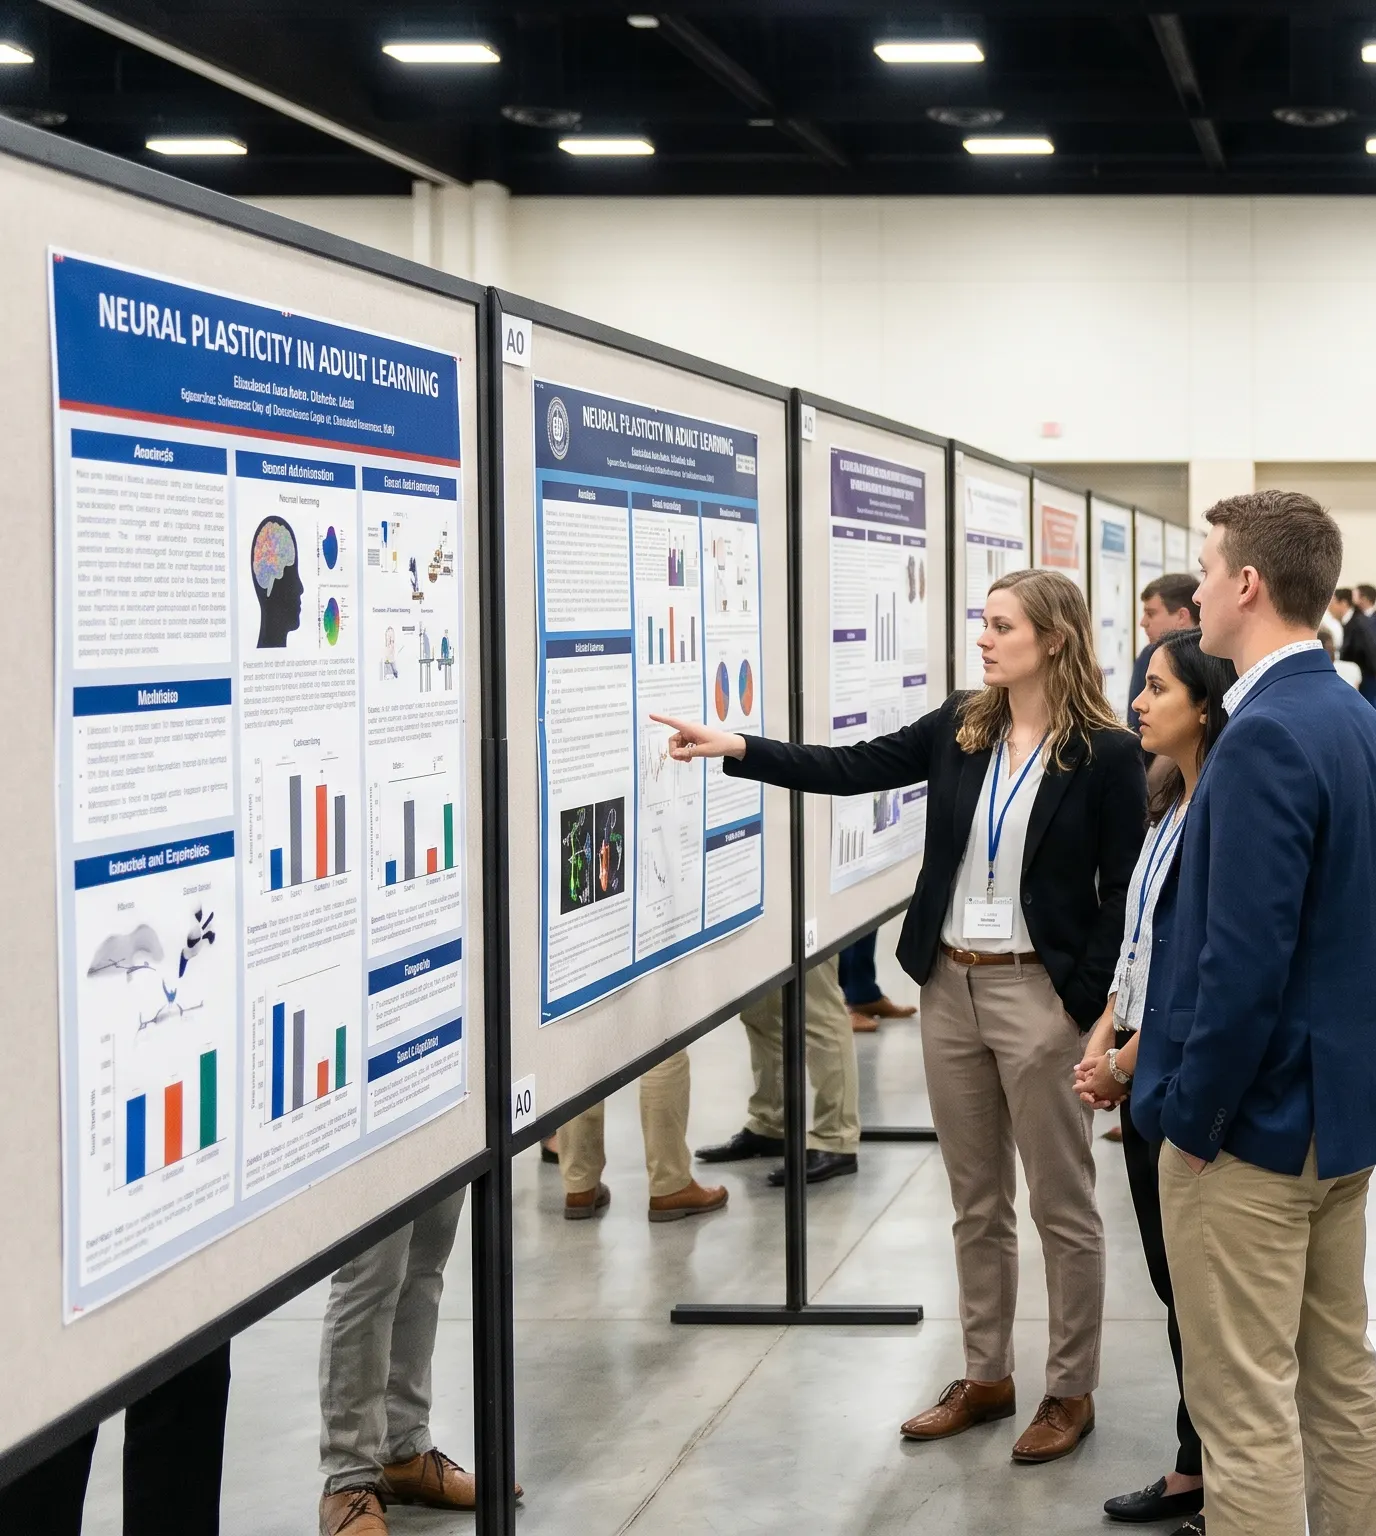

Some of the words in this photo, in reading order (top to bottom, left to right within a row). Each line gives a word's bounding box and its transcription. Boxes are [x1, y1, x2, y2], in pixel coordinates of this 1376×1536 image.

[99, 292, 187, 344] NEURAL
[192, 314, 293, 366] PLASTICITY
[297, 339, 315, 371] IN
[319, 345, 368, 381] ADULT
[372, 357, 439, 398] LEARNING
[506, 328, 525, 355] A0
[583, 405, 619, 433] NEURAL
[515, 1089, 531, 1119] A0
